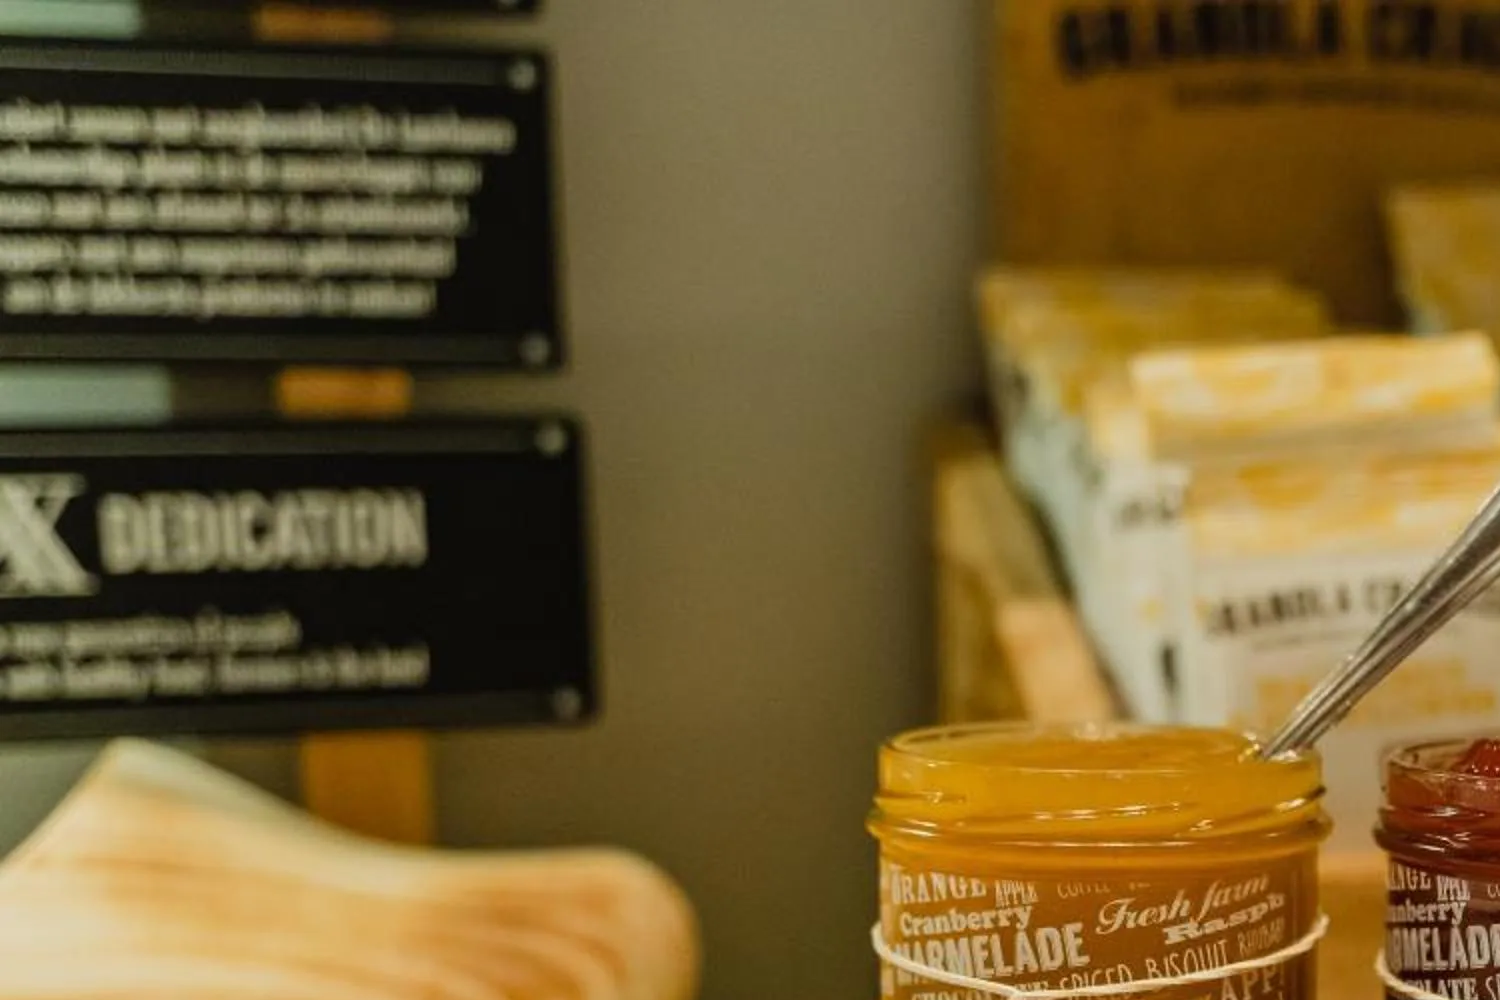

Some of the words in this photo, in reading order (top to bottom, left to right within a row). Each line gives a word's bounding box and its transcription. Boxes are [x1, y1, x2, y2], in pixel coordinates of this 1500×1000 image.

[98, 488, 428, 575] DEDICATION
[901, 905, 1033, 936] Cranberry
[1096, 890, 1192, 935] Fresh
[1145, 939, 1229, 981] BISQUIT
